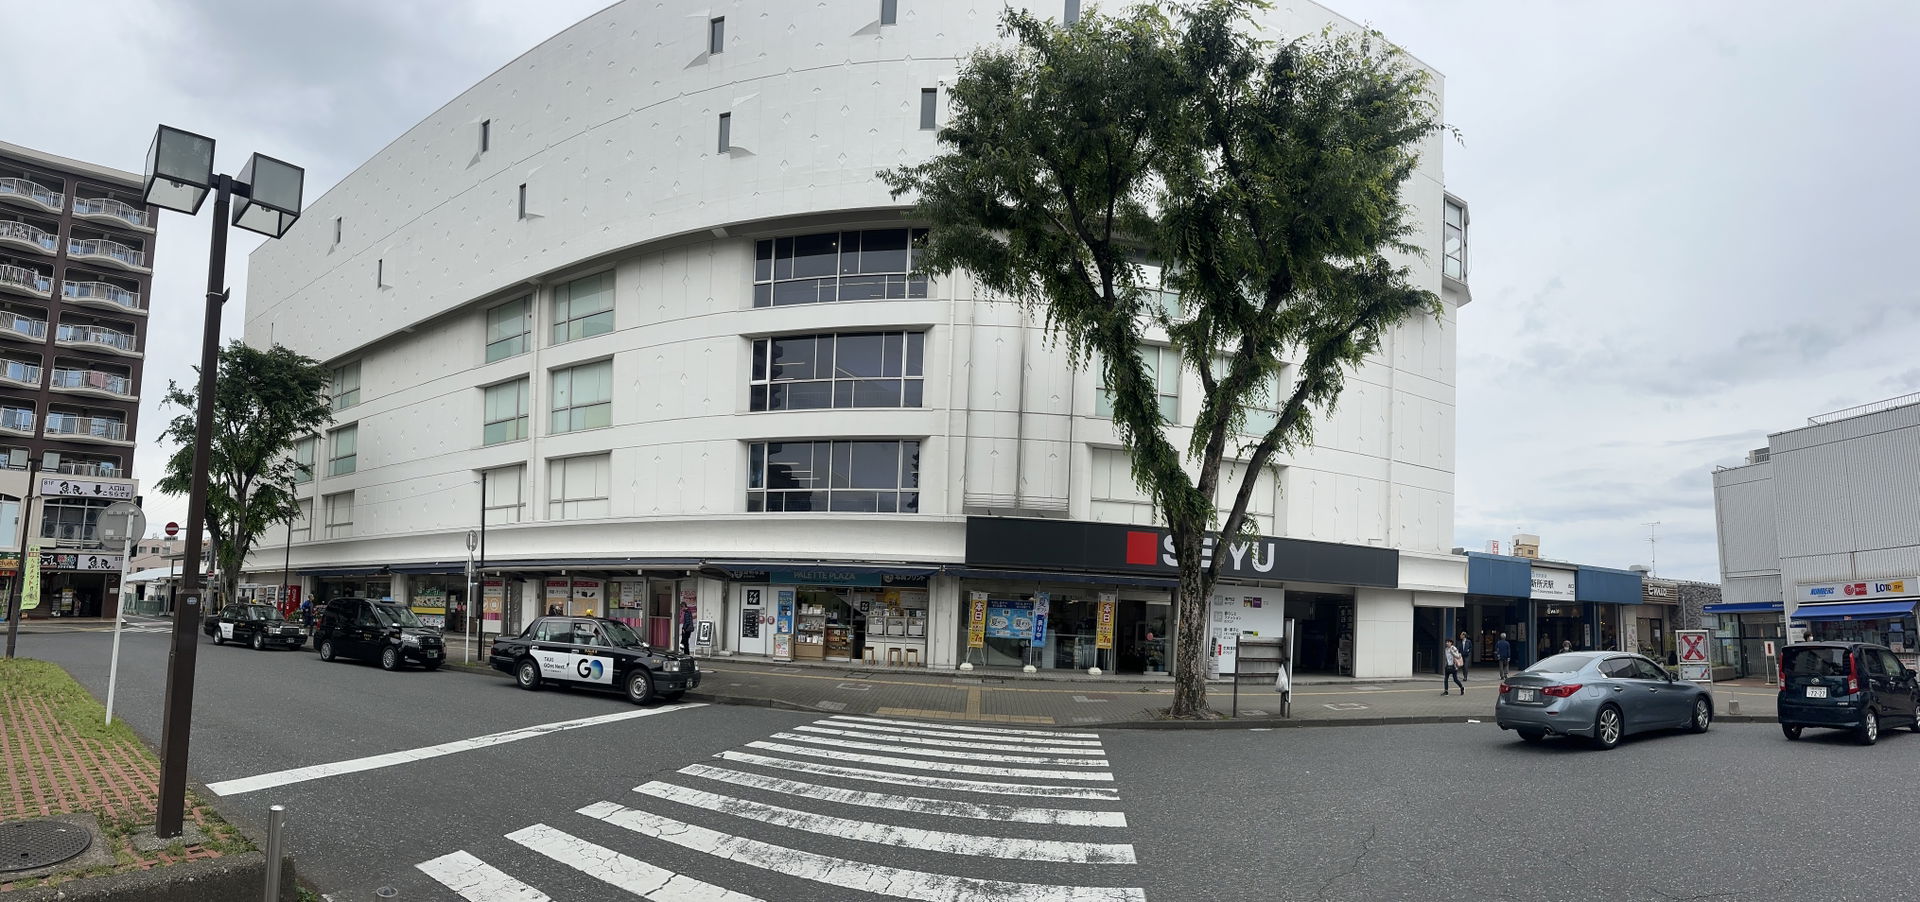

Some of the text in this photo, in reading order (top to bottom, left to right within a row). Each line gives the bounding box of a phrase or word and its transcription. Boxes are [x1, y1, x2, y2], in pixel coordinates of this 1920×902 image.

[60, 481, 83, 495] 魚民
[1162, 535, 1275, 573] SEYU
[88, 556, 111, 570] 魚民
[793, 571, 856, 580] PALETTE PLAZA
[1809, 587, 1835, 596] NUMBERS
[974, 601, 984, 621] 本日
[1103, 602, 1112, 623] 本日
[577, 658, 604, 681] GO
